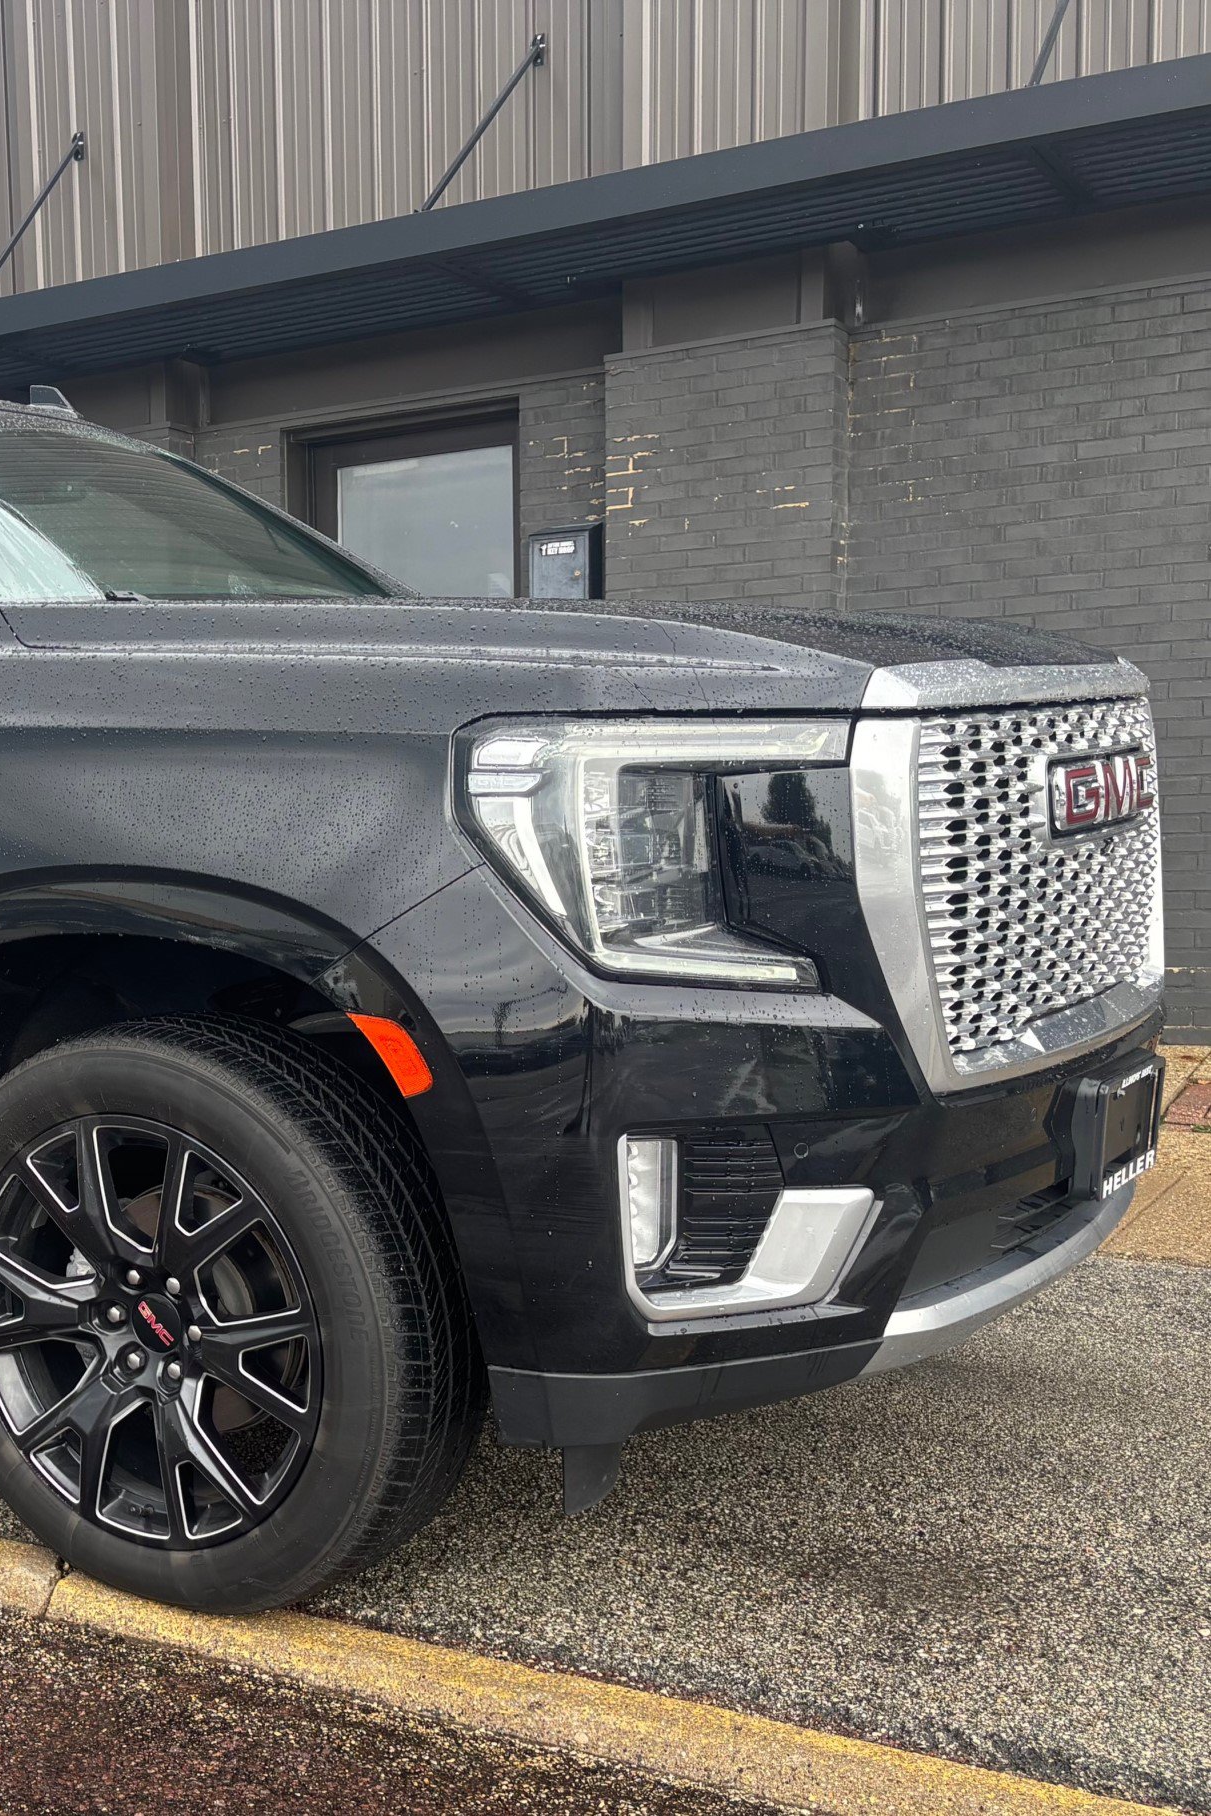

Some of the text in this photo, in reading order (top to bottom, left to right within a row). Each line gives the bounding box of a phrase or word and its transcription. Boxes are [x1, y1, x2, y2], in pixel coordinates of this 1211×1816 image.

[1054, 754, 1154, 830] GMC
[1102, 1149, 1155, 1199] HELLER
[284, 1170, 369, 1342] BRIDGESTONE
[137, 1300, 174, 1347] GMC
